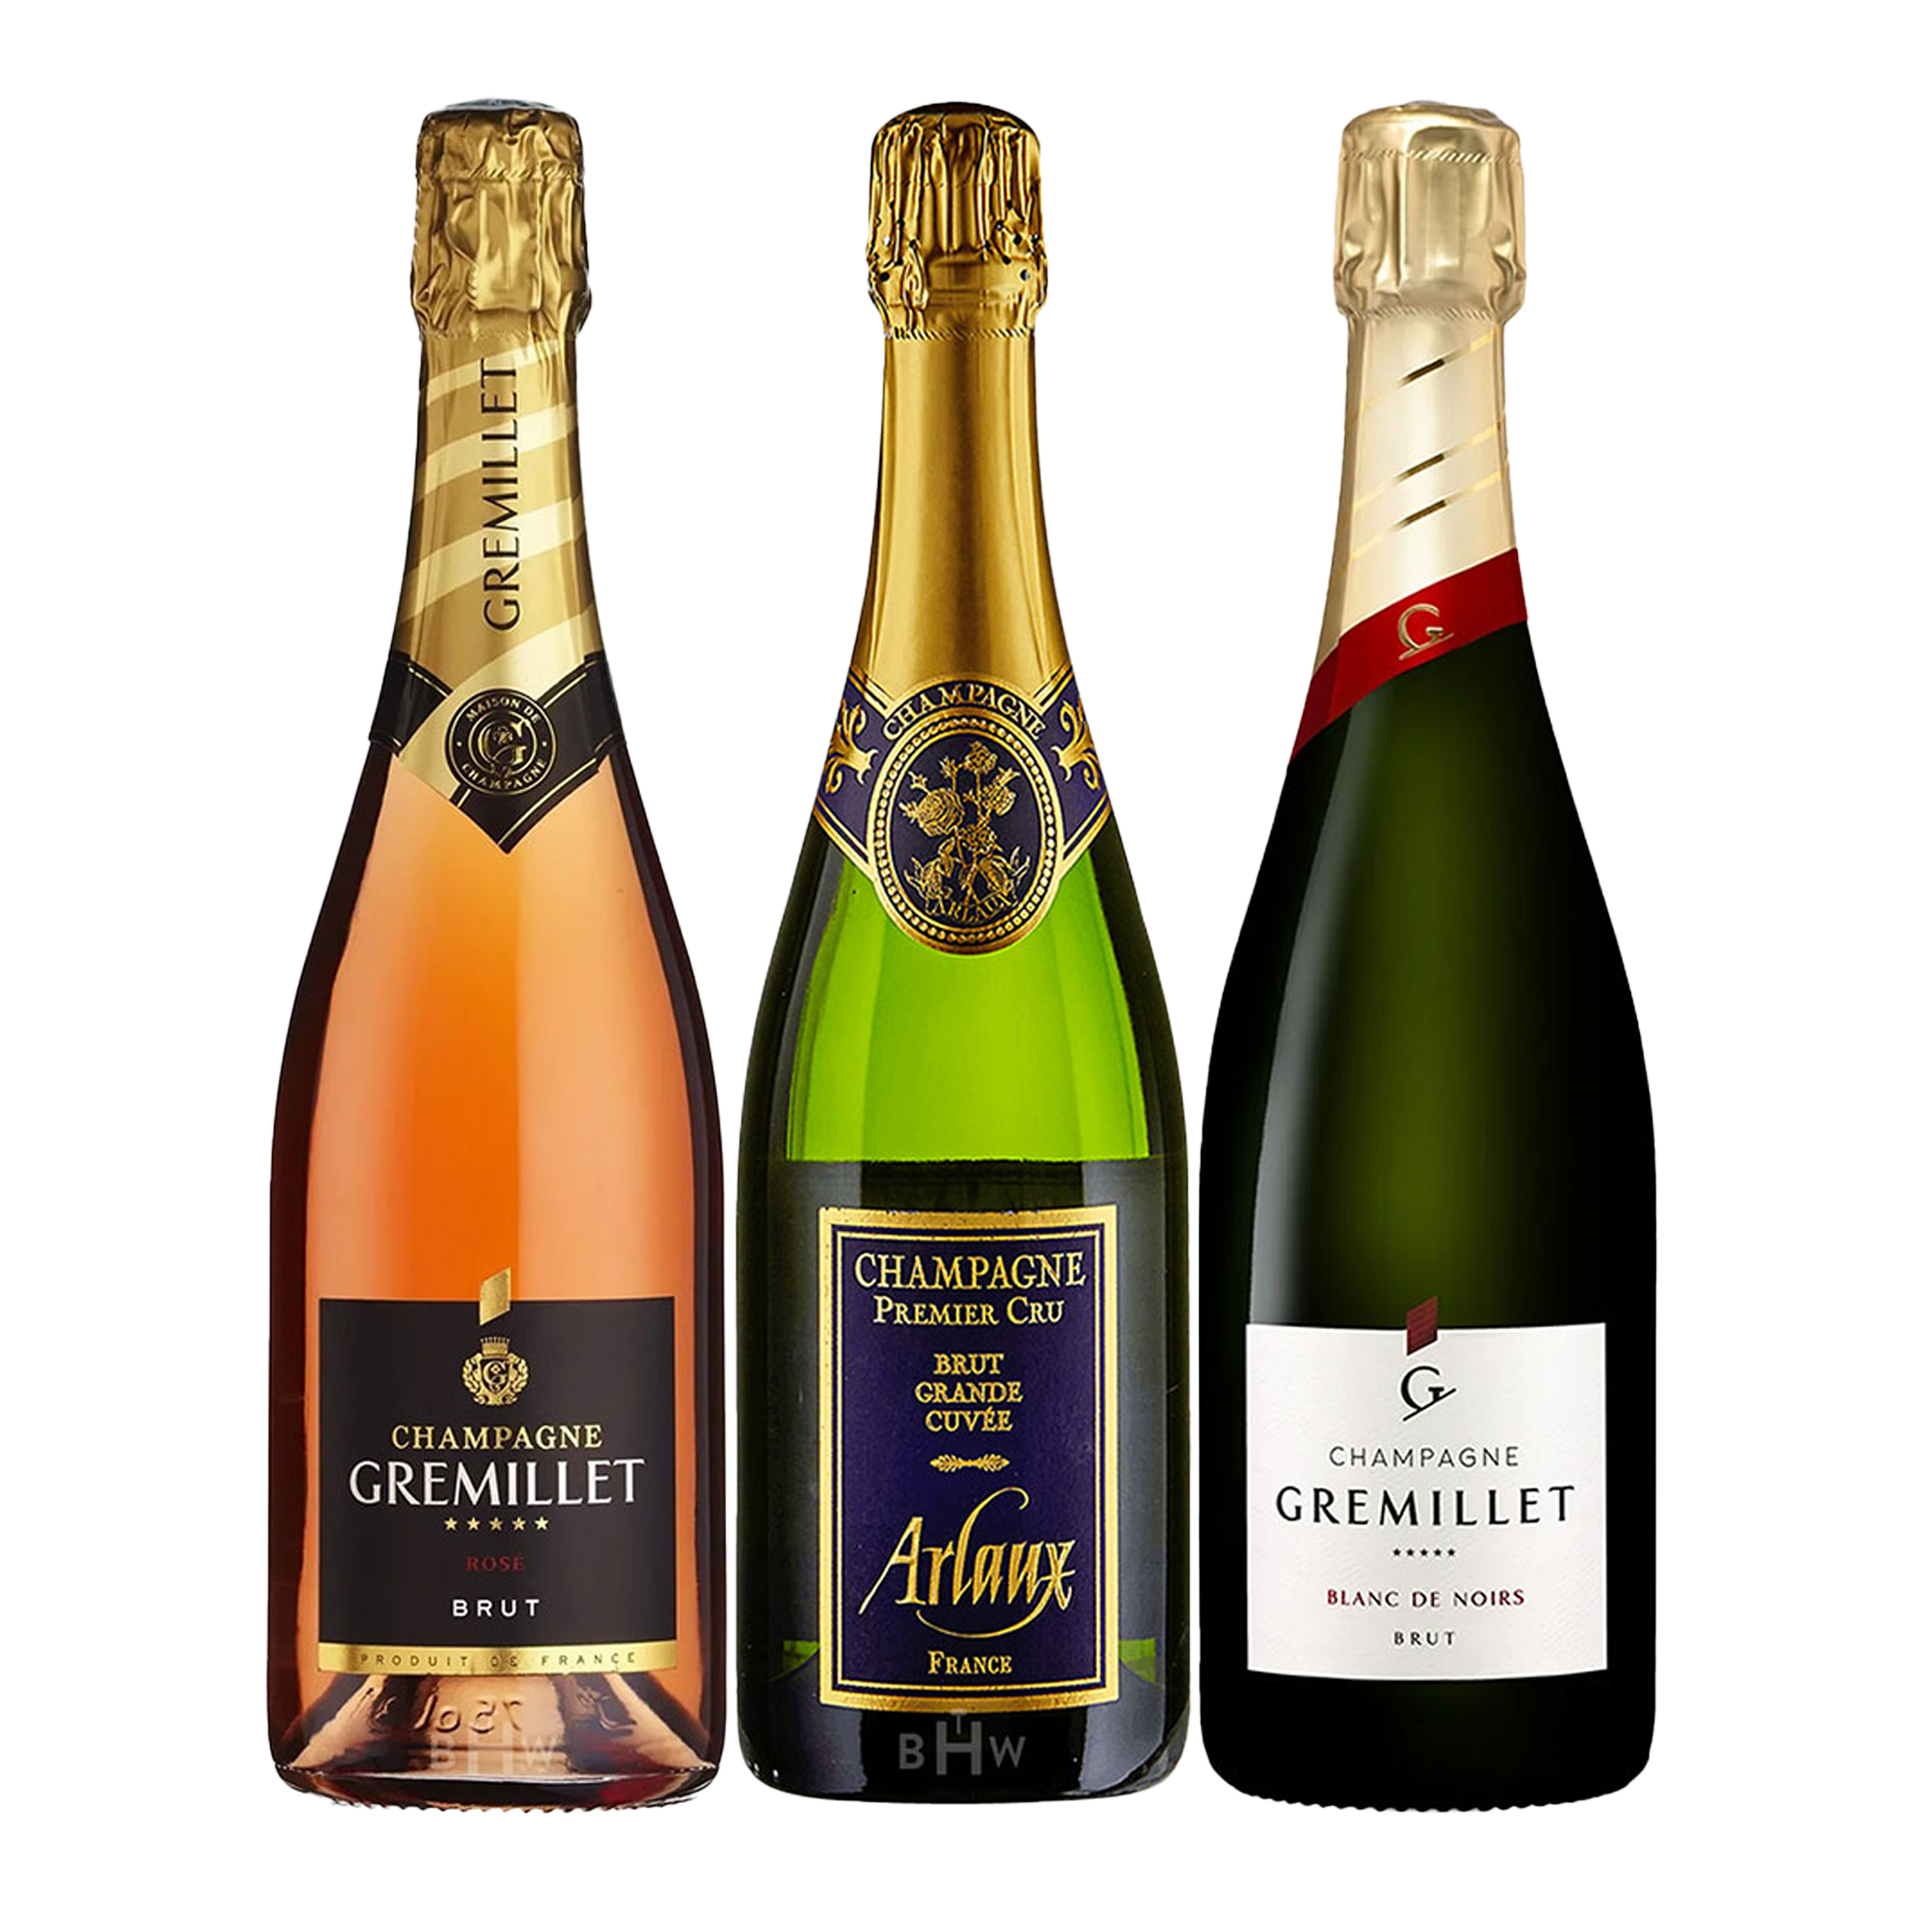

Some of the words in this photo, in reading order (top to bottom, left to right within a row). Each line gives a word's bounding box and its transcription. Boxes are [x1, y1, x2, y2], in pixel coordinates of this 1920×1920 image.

[480, 356, 521, 632] GREMILLET
[465, 695, 521, 722] MAISON
[523, 705, 542, 724] DE
[882, 683, 1047, 741] CHAMPAGNE
[461, 757, 547, 790] CHAMPAGNE
[854, 1251, 1087, 1290] CHAMPAGNE
[932, 1352, 1005, 1376] BRUT
[914, 1380, 1024, 1403] GRANDE
[924, 1405, 1014, 1432] CUVÉE
[391, 1424, 604, 1450] CHAMPAGNE
[1328, 1445, 1520, 1468] CHAMPAGNE
[349, 1457, 646, 1506] GREMILLET
[1275, 1484, 1576, 1526] GREMILLET
[465, 1553, 526, 1573] ROSÉ
[858, 1486, 1076, 1638] Arlaux
[452, 1598, 541, 1618] BRUT
[1326, 1588, 1400, 1609] BLANC
[1412, 1590, 1441, 1609] DE
[1453, 1588, 1526, 1609] NOIRS
[1393, 1631, 1456, 1647] BRUT
[359, 1654, 469, 1668] PRODUIT
[540, 1651, 637, 1667] FRANCE
